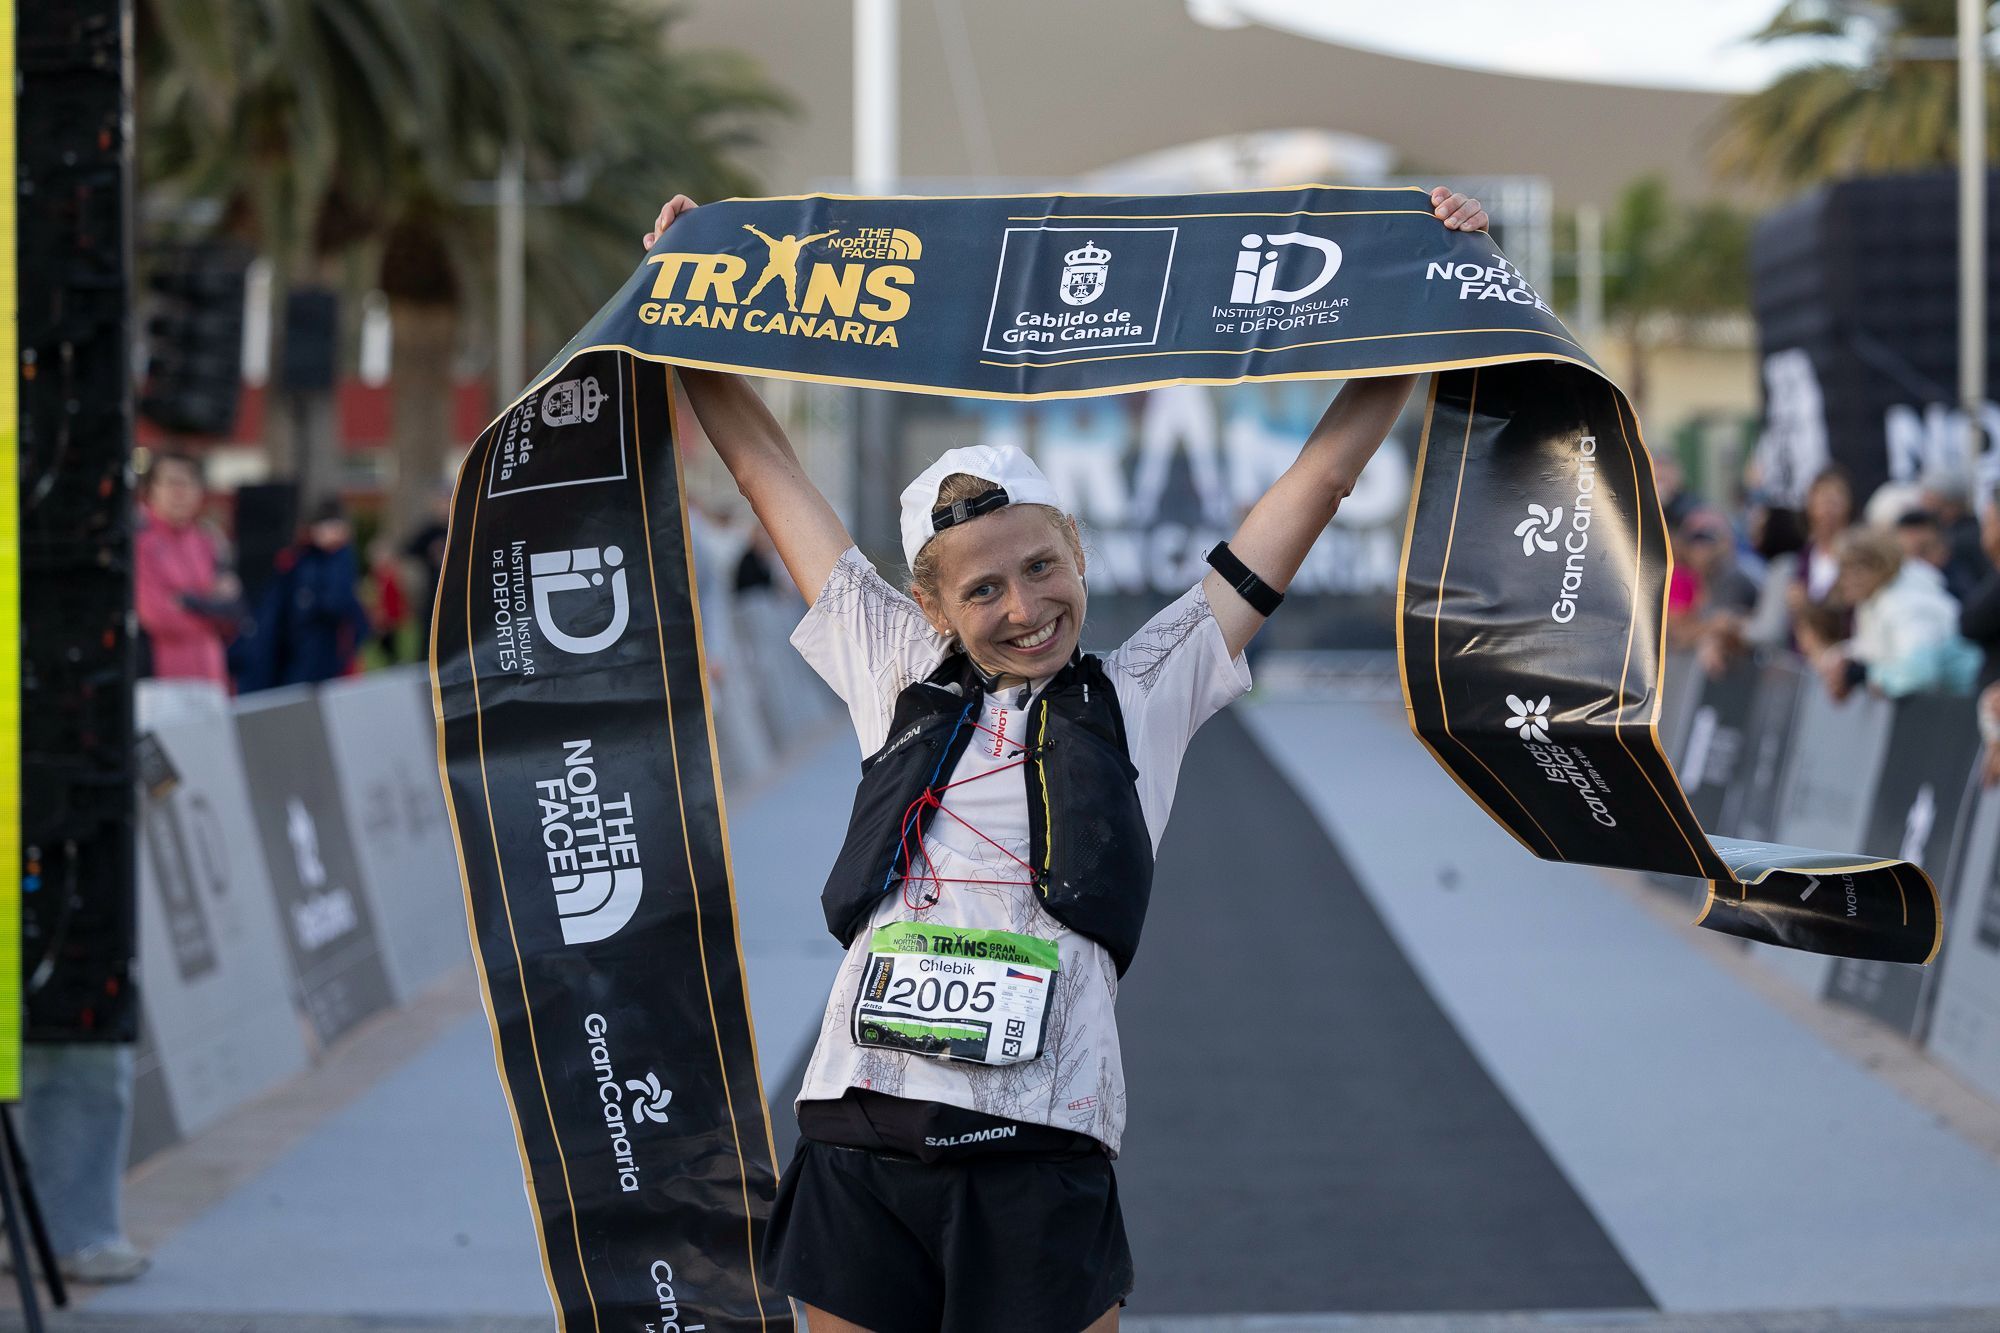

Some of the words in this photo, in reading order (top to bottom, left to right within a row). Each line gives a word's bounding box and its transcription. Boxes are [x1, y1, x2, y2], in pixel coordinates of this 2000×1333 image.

[828, 238, 889, 249] NORTH
[858, 228, 892, 238] THE
[841, 248, 887, 259] FACE
[1425, 262, 1543, 301] NORT
[638, 302, 738, 331] GRAN
[742, 310, 899, 348] CANARIA
[1015, 311, 1098, 328] Cabildo
[1103, 308, 1131, 323] de
[1212, 305, 1284, 318] INSTITUTO
[1289, 298, 1349, 315] INSULAR
[1215, 323, 1235, 333] DE
[1240, 311, 1340, 333] DEPORTES
[1002, 329, 1055, 343] Gran
[1060, 323, 1143, 341] Canaria
[521, 393, 539, 433] ildo
[501, 404, 525, 481] Canaria
[519, 438, 533, 464] de
[1551, 436, 1596, 624] GranCanaria
[492, 549, 504, 568] DE
[511, 541, 527, 612] INSTITUTO
[493, 572, 518, 671] DEPORTES
[516, 616, 535, 676] INSULAR
[993, 708, 1008, 757] LOMON
[1522, 743, 1569, 783] Islas
[563, 739, 610, 870] NORTH
[1544, 745, 1617, 827] Canarias
[535, 778, 579, 873] FACE
[603, 792, 640, 866] THE
[919, 959, 975, 975] Chlebik
[989, 943, 1016, 954] GRAN
[989, 951, 1030, 964] CANARIA
[862, 1002, 883, 1010] Arista
[887, 977, 996, 1013] 2005
[584, 1013, 640, 1193] GranCanaria
[924, 1125, 1017, 1147] SALOMON
